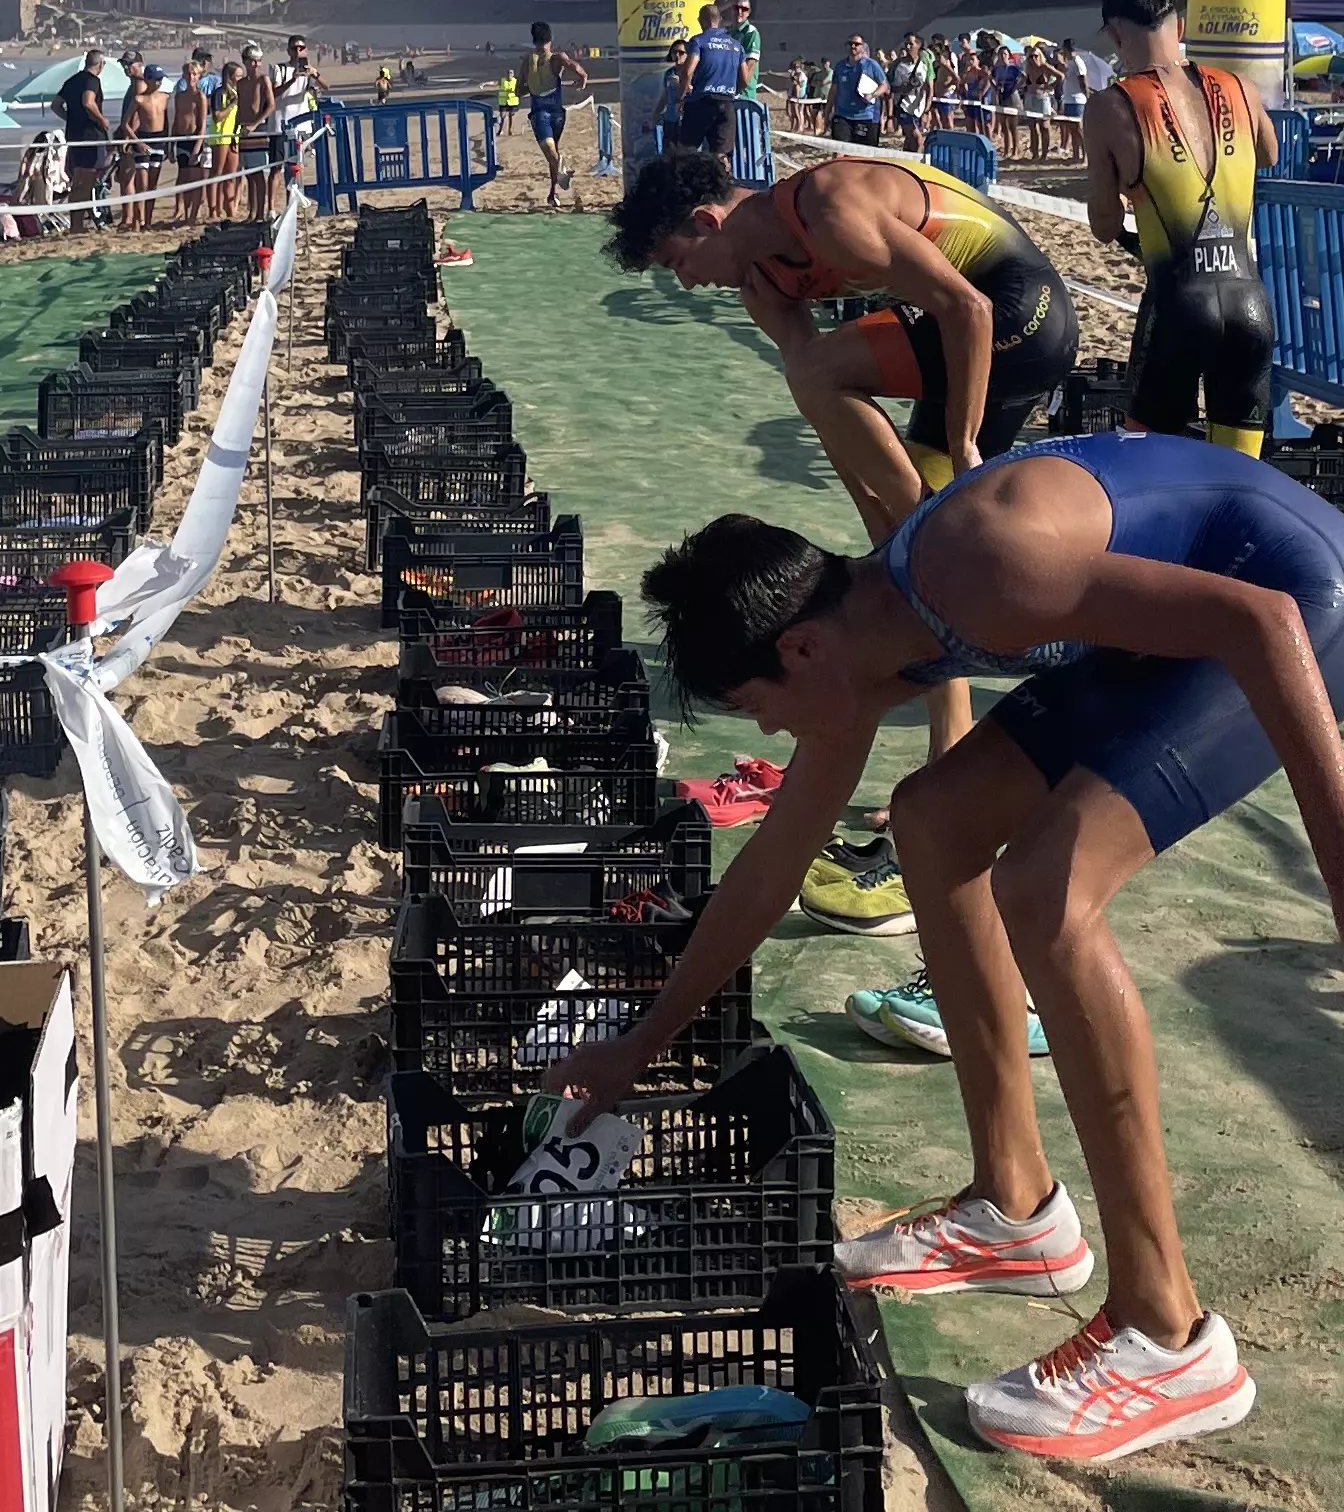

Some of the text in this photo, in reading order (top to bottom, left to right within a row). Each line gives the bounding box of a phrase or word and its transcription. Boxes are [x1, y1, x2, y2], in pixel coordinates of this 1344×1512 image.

[639, 25, 690, 41] OLIMPO
[1205, 21, 1259, 36] OLIMPO
[1194, 244, 1238, 273] PLAZA
